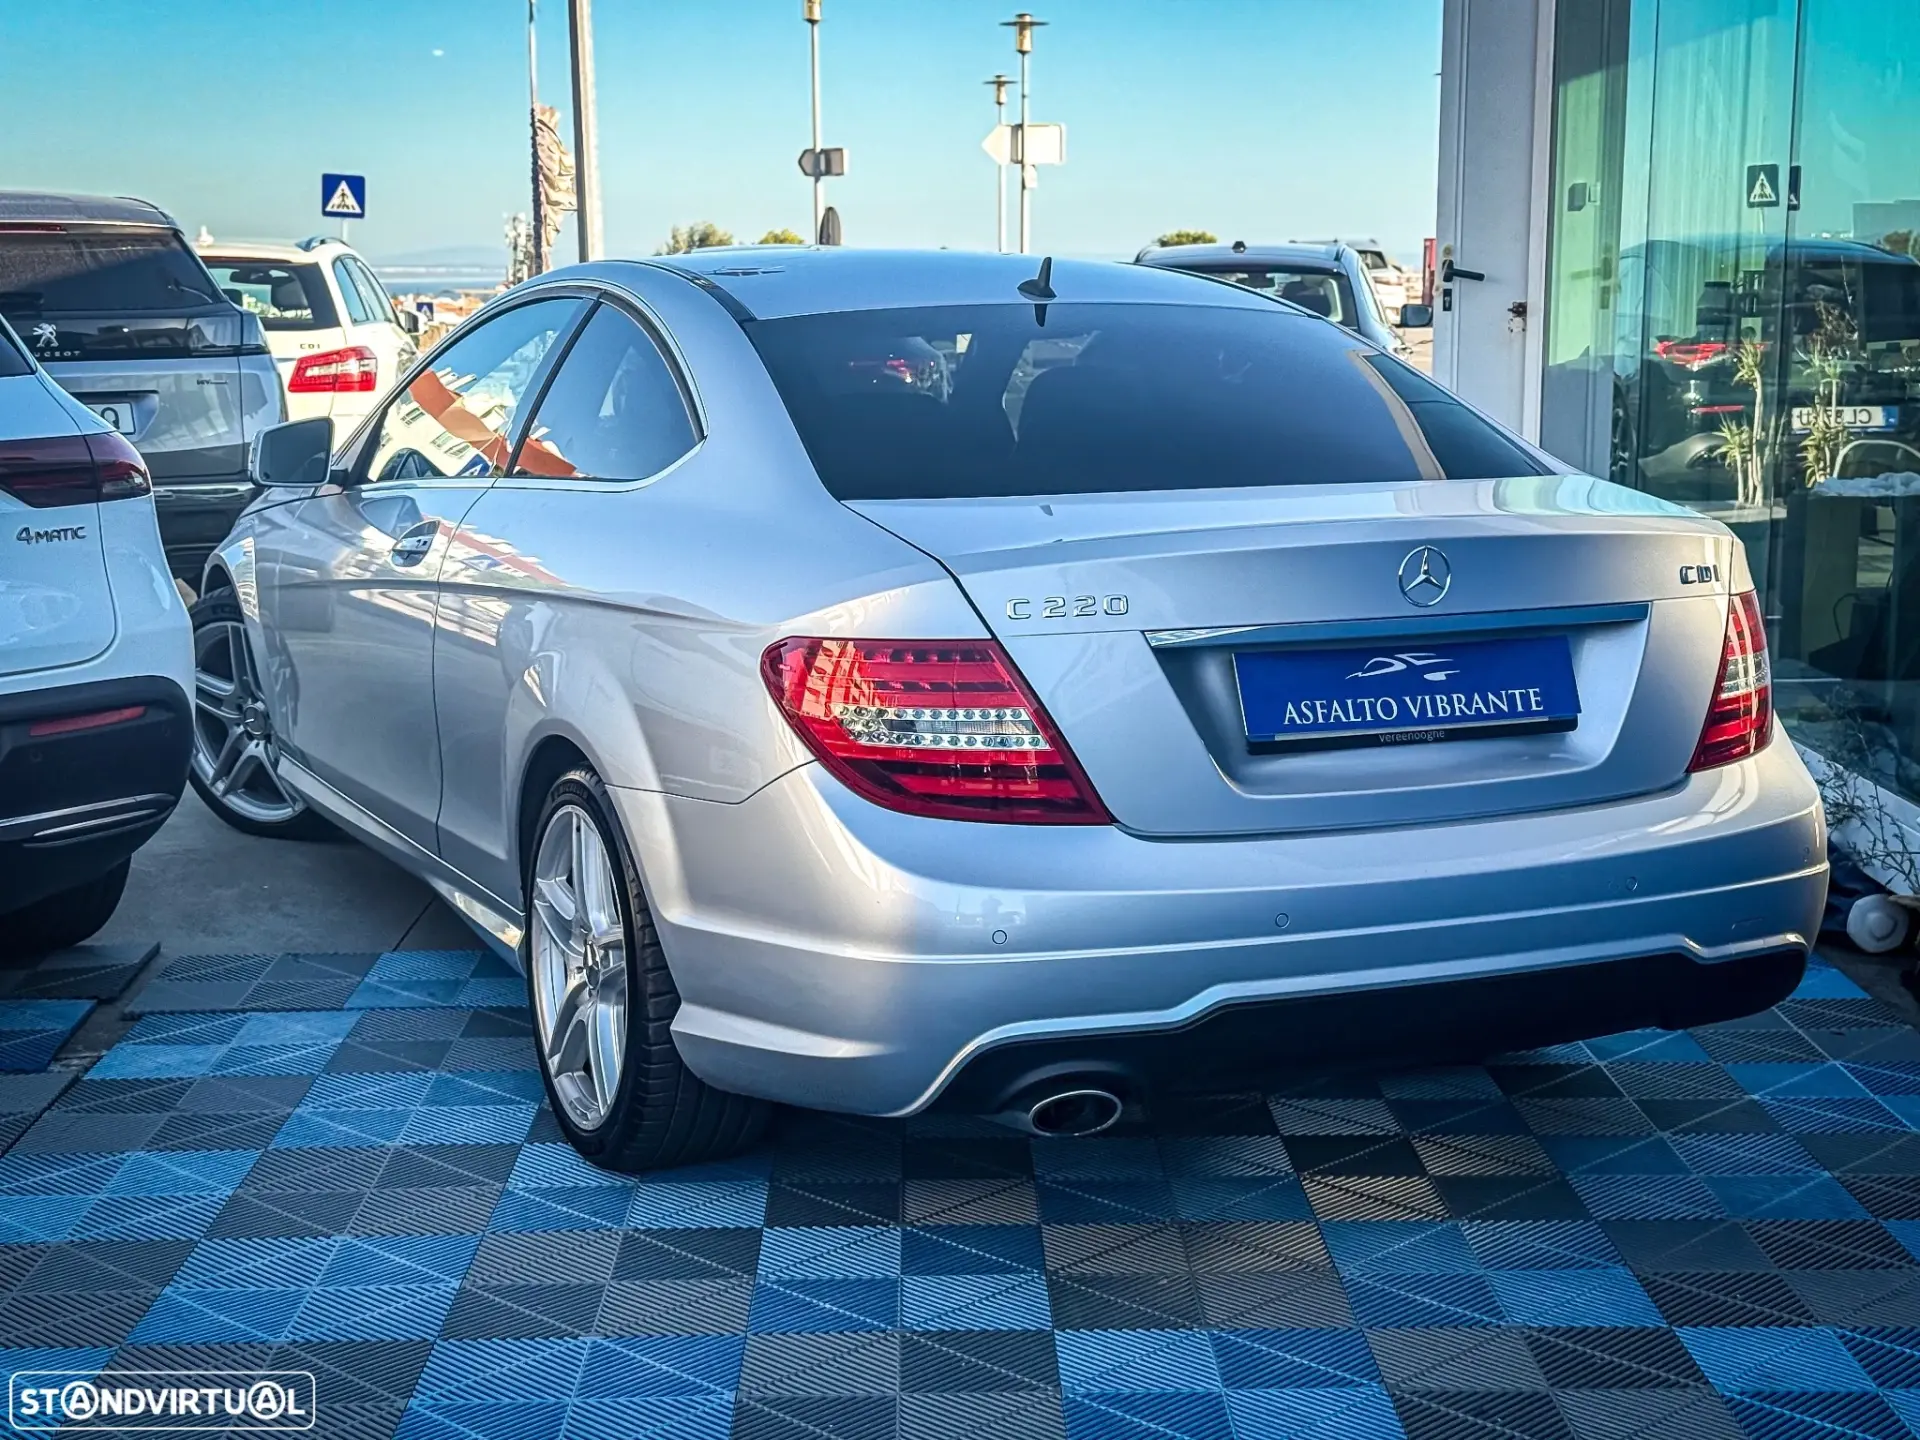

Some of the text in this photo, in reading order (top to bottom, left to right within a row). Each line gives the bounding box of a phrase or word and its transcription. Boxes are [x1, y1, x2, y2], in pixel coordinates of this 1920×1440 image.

[1679, 564, 1720, 585] CDI
[1006, 594, 1130, 620] C 220
[1283, 687, 1545, 726] ASFALTO VIBRANTE
